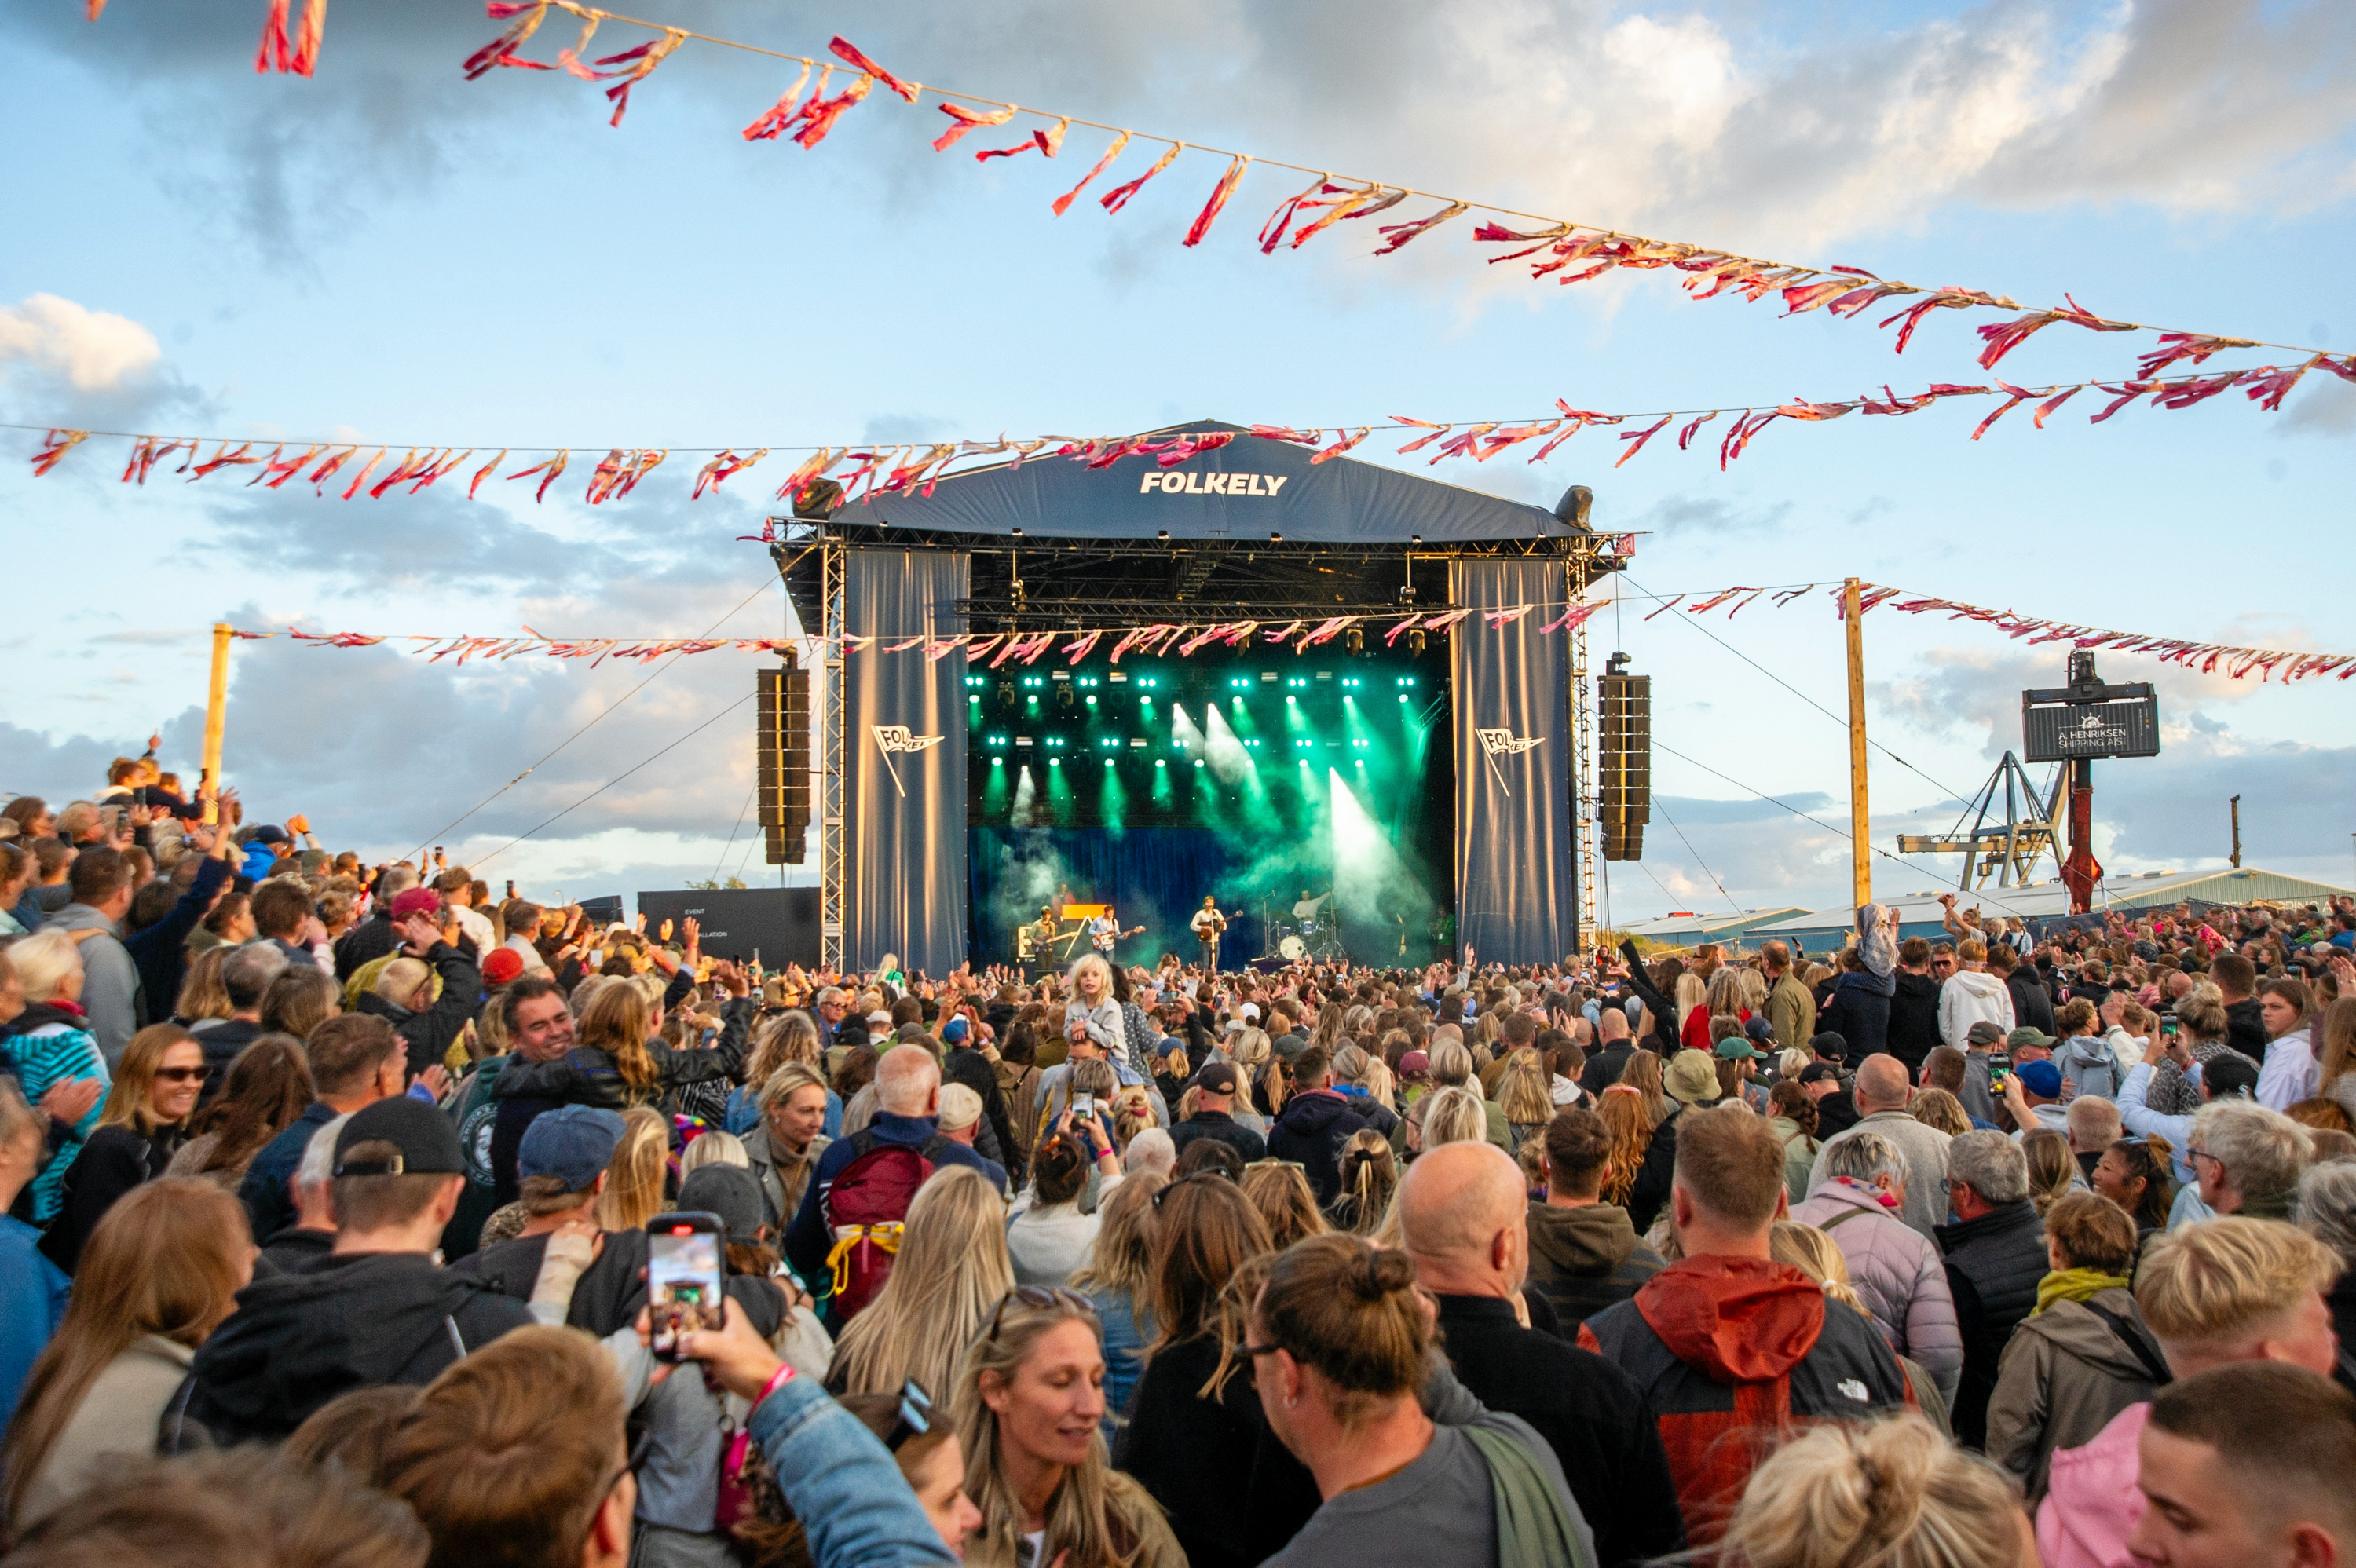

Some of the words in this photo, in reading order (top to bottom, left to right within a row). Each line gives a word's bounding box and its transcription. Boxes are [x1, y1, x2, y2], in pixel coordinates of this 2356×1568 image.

[1140, 472, 1287, 496] FOLKELY
[2070, 729, 2127, 739] HENRIKSEN
[2058, 739, 2104, 749] SHIPPING
